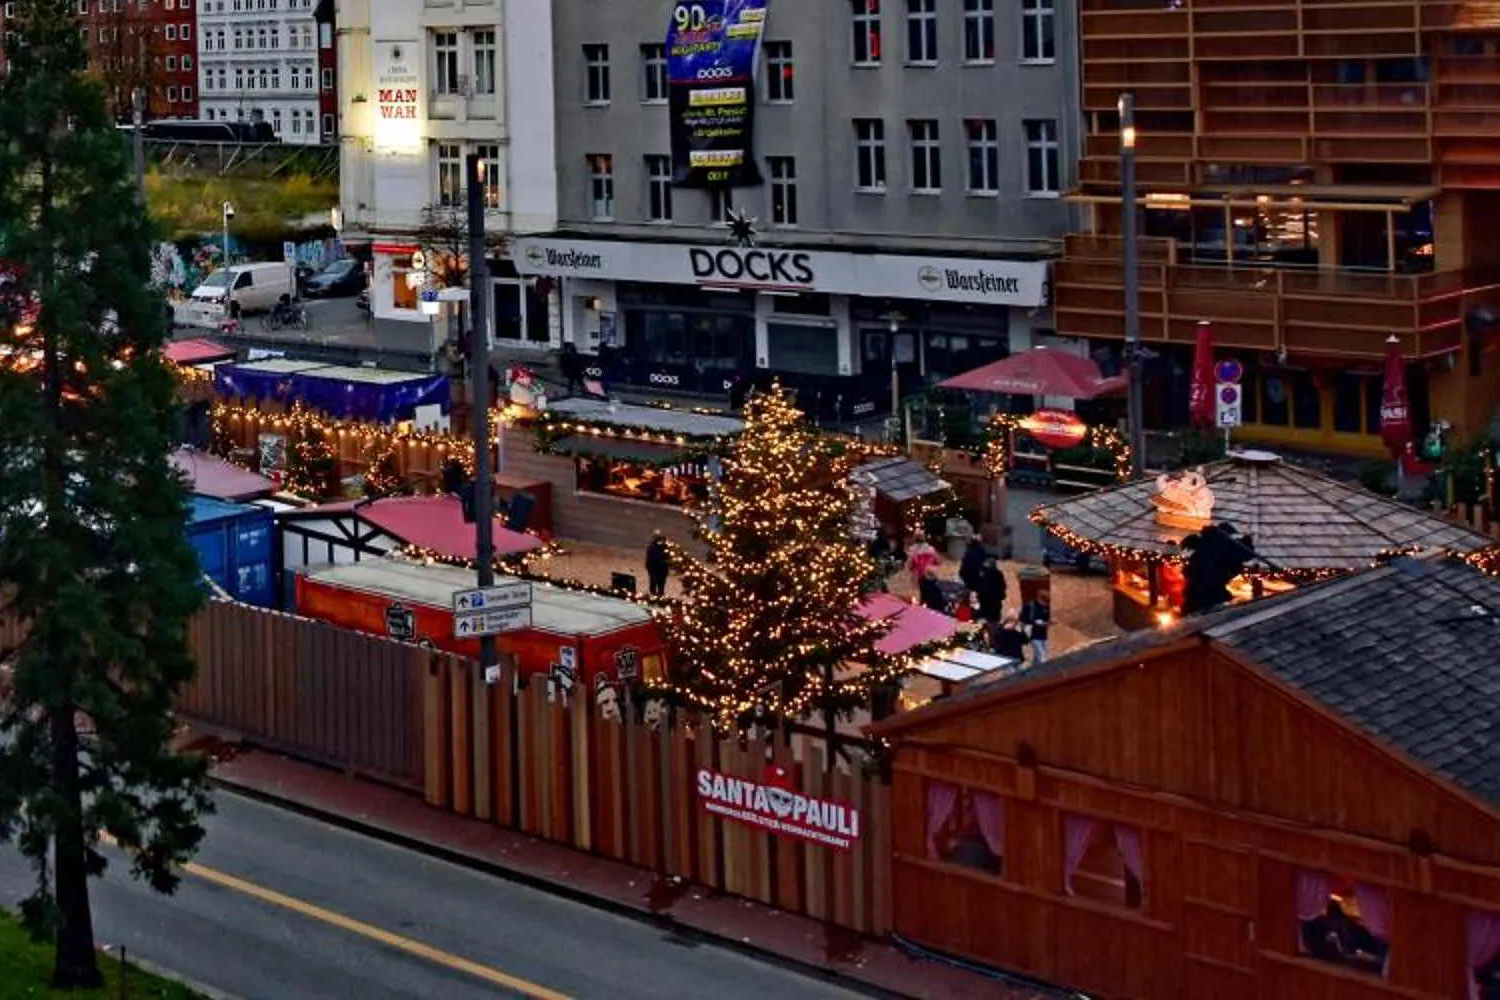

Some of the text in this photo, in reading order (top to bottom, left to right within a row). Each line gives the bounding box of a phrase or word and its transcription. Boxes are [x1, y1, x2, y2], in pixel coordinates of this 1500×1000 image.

[378, 89, 417, 103] MAN
[379, 105, 417, 119] WAH
[690, 248, 814, 284] DOCKS
[945, 268, 1019, 295] Warsteiner
[697, 770, 771, 813] SANTA
[792, 794, 860, 838] PAULI
